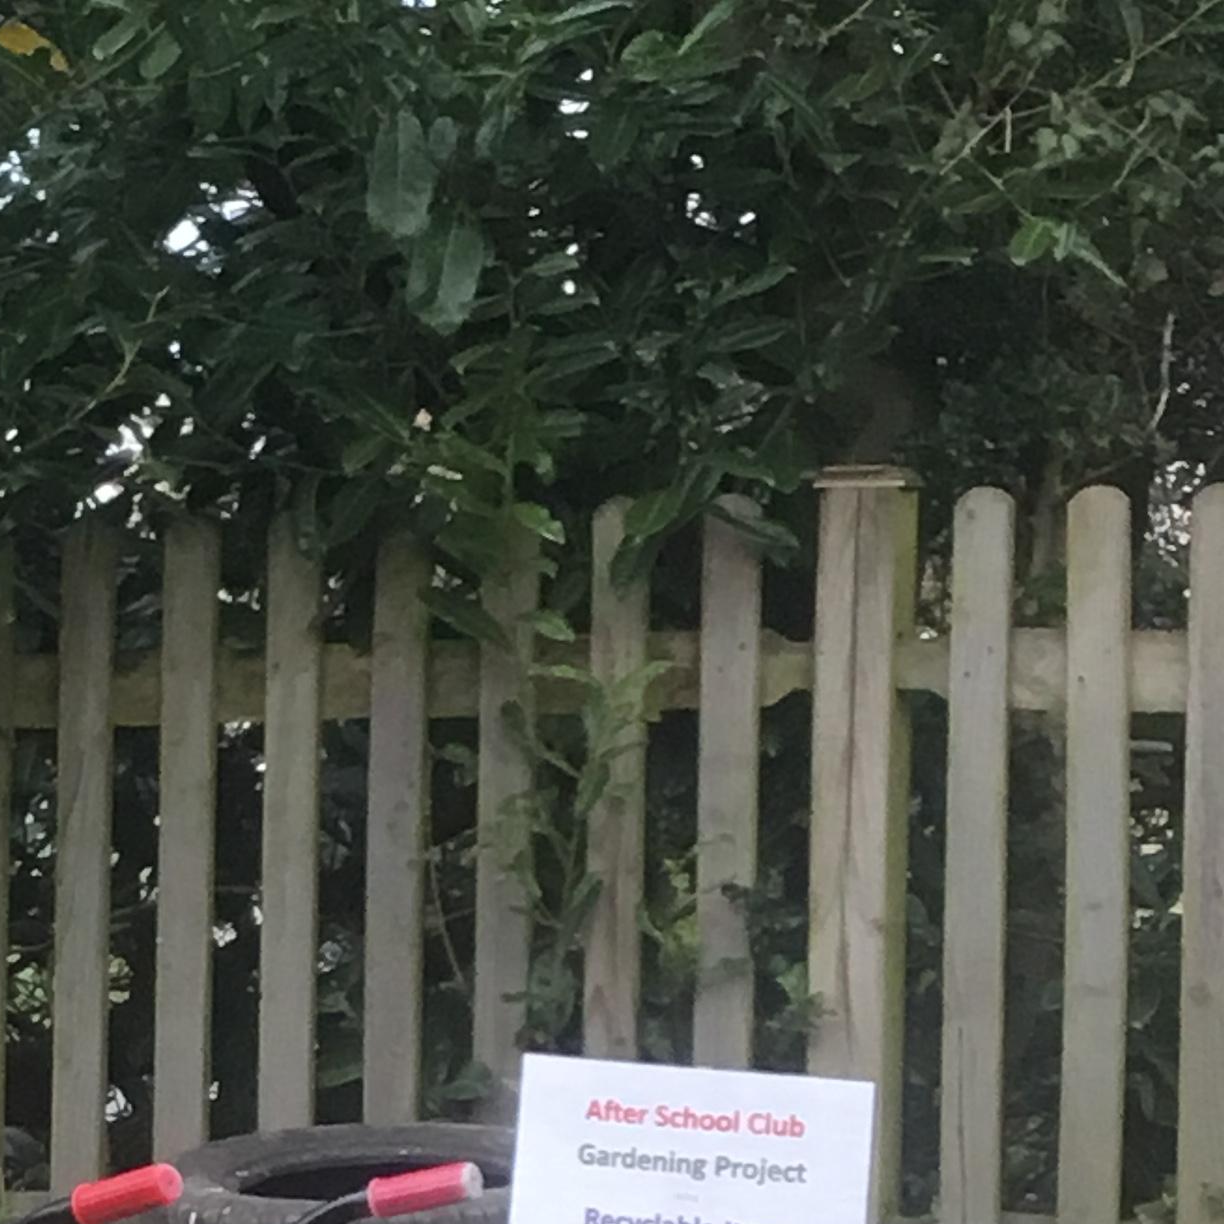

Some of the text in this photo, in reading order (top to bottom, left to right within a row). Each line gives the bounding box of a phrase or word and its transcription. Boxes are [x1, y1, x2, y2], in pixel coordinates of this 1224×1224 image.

[586, 1099, 806, 1138] After School Club
[577, 1143, 808, 1186] Gardening Project
